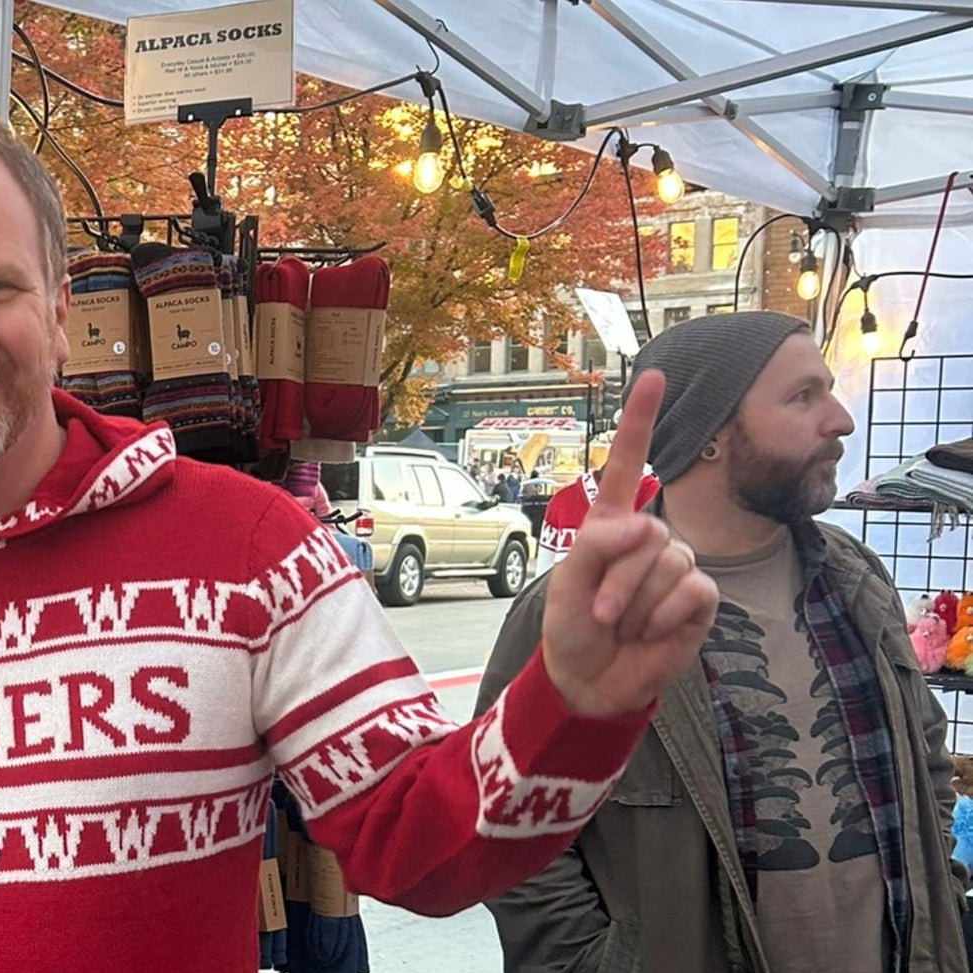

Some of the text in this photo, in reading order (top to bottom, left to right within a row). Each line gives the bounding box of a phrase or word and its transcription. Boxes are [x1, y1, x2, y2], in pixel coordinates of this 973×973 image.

[135, 22, 283, 53] ALPACA SOCKS
[96, 295, 120, 304] SOCKS
[155, 295, 210, 309] ALPACA SOCKS
[81, 338, 106, 348] CAMPO
[171, 340, 197, 350] CAMPO
